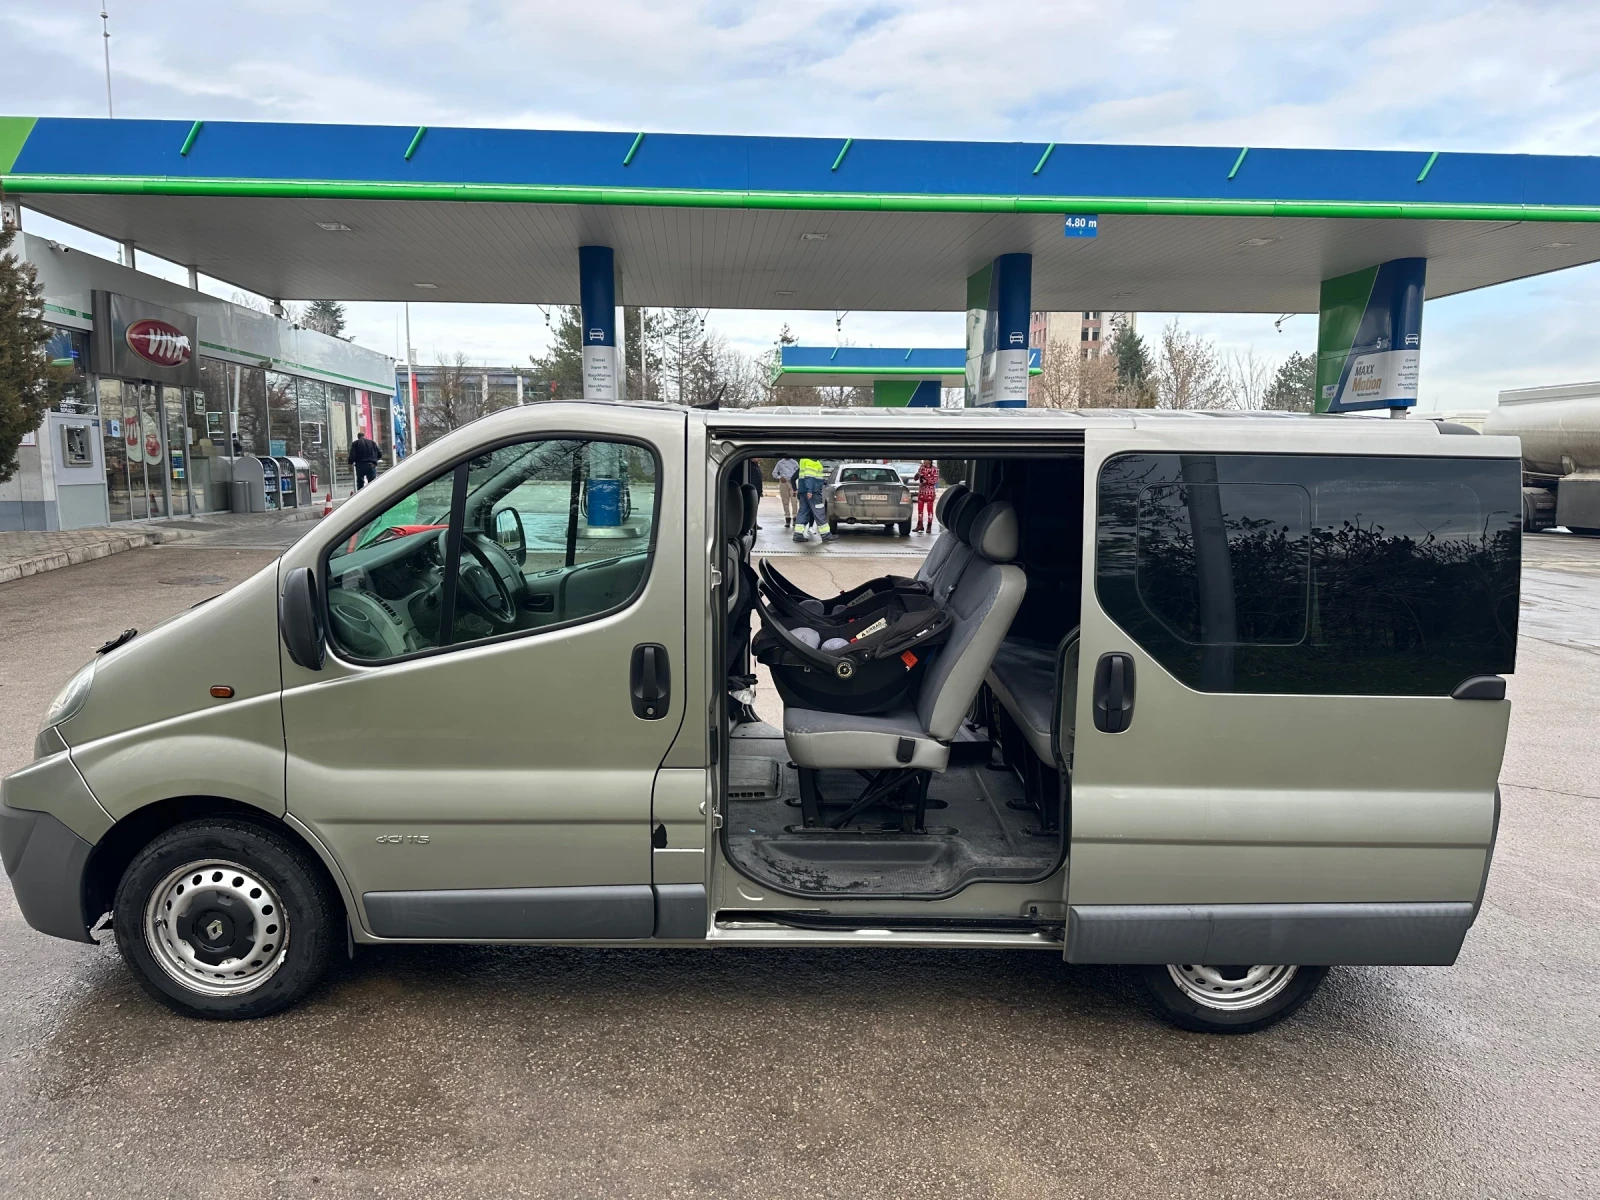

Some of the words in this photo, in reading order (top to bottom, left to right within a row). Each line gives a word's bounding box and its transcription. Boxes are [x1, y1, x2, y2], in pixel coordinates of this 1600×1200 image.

[1065, 217, 1086, 228] 4.80
[1088, 220, 1097, 228] m
[148, 327, 184, 361] VIVA
[1376, 337, 1382, 349] 5
[1354, 364, 1375, 376] MAXX
[1352, 377, 1382, 392] Motion
[406, 835, 430, 844] 115
